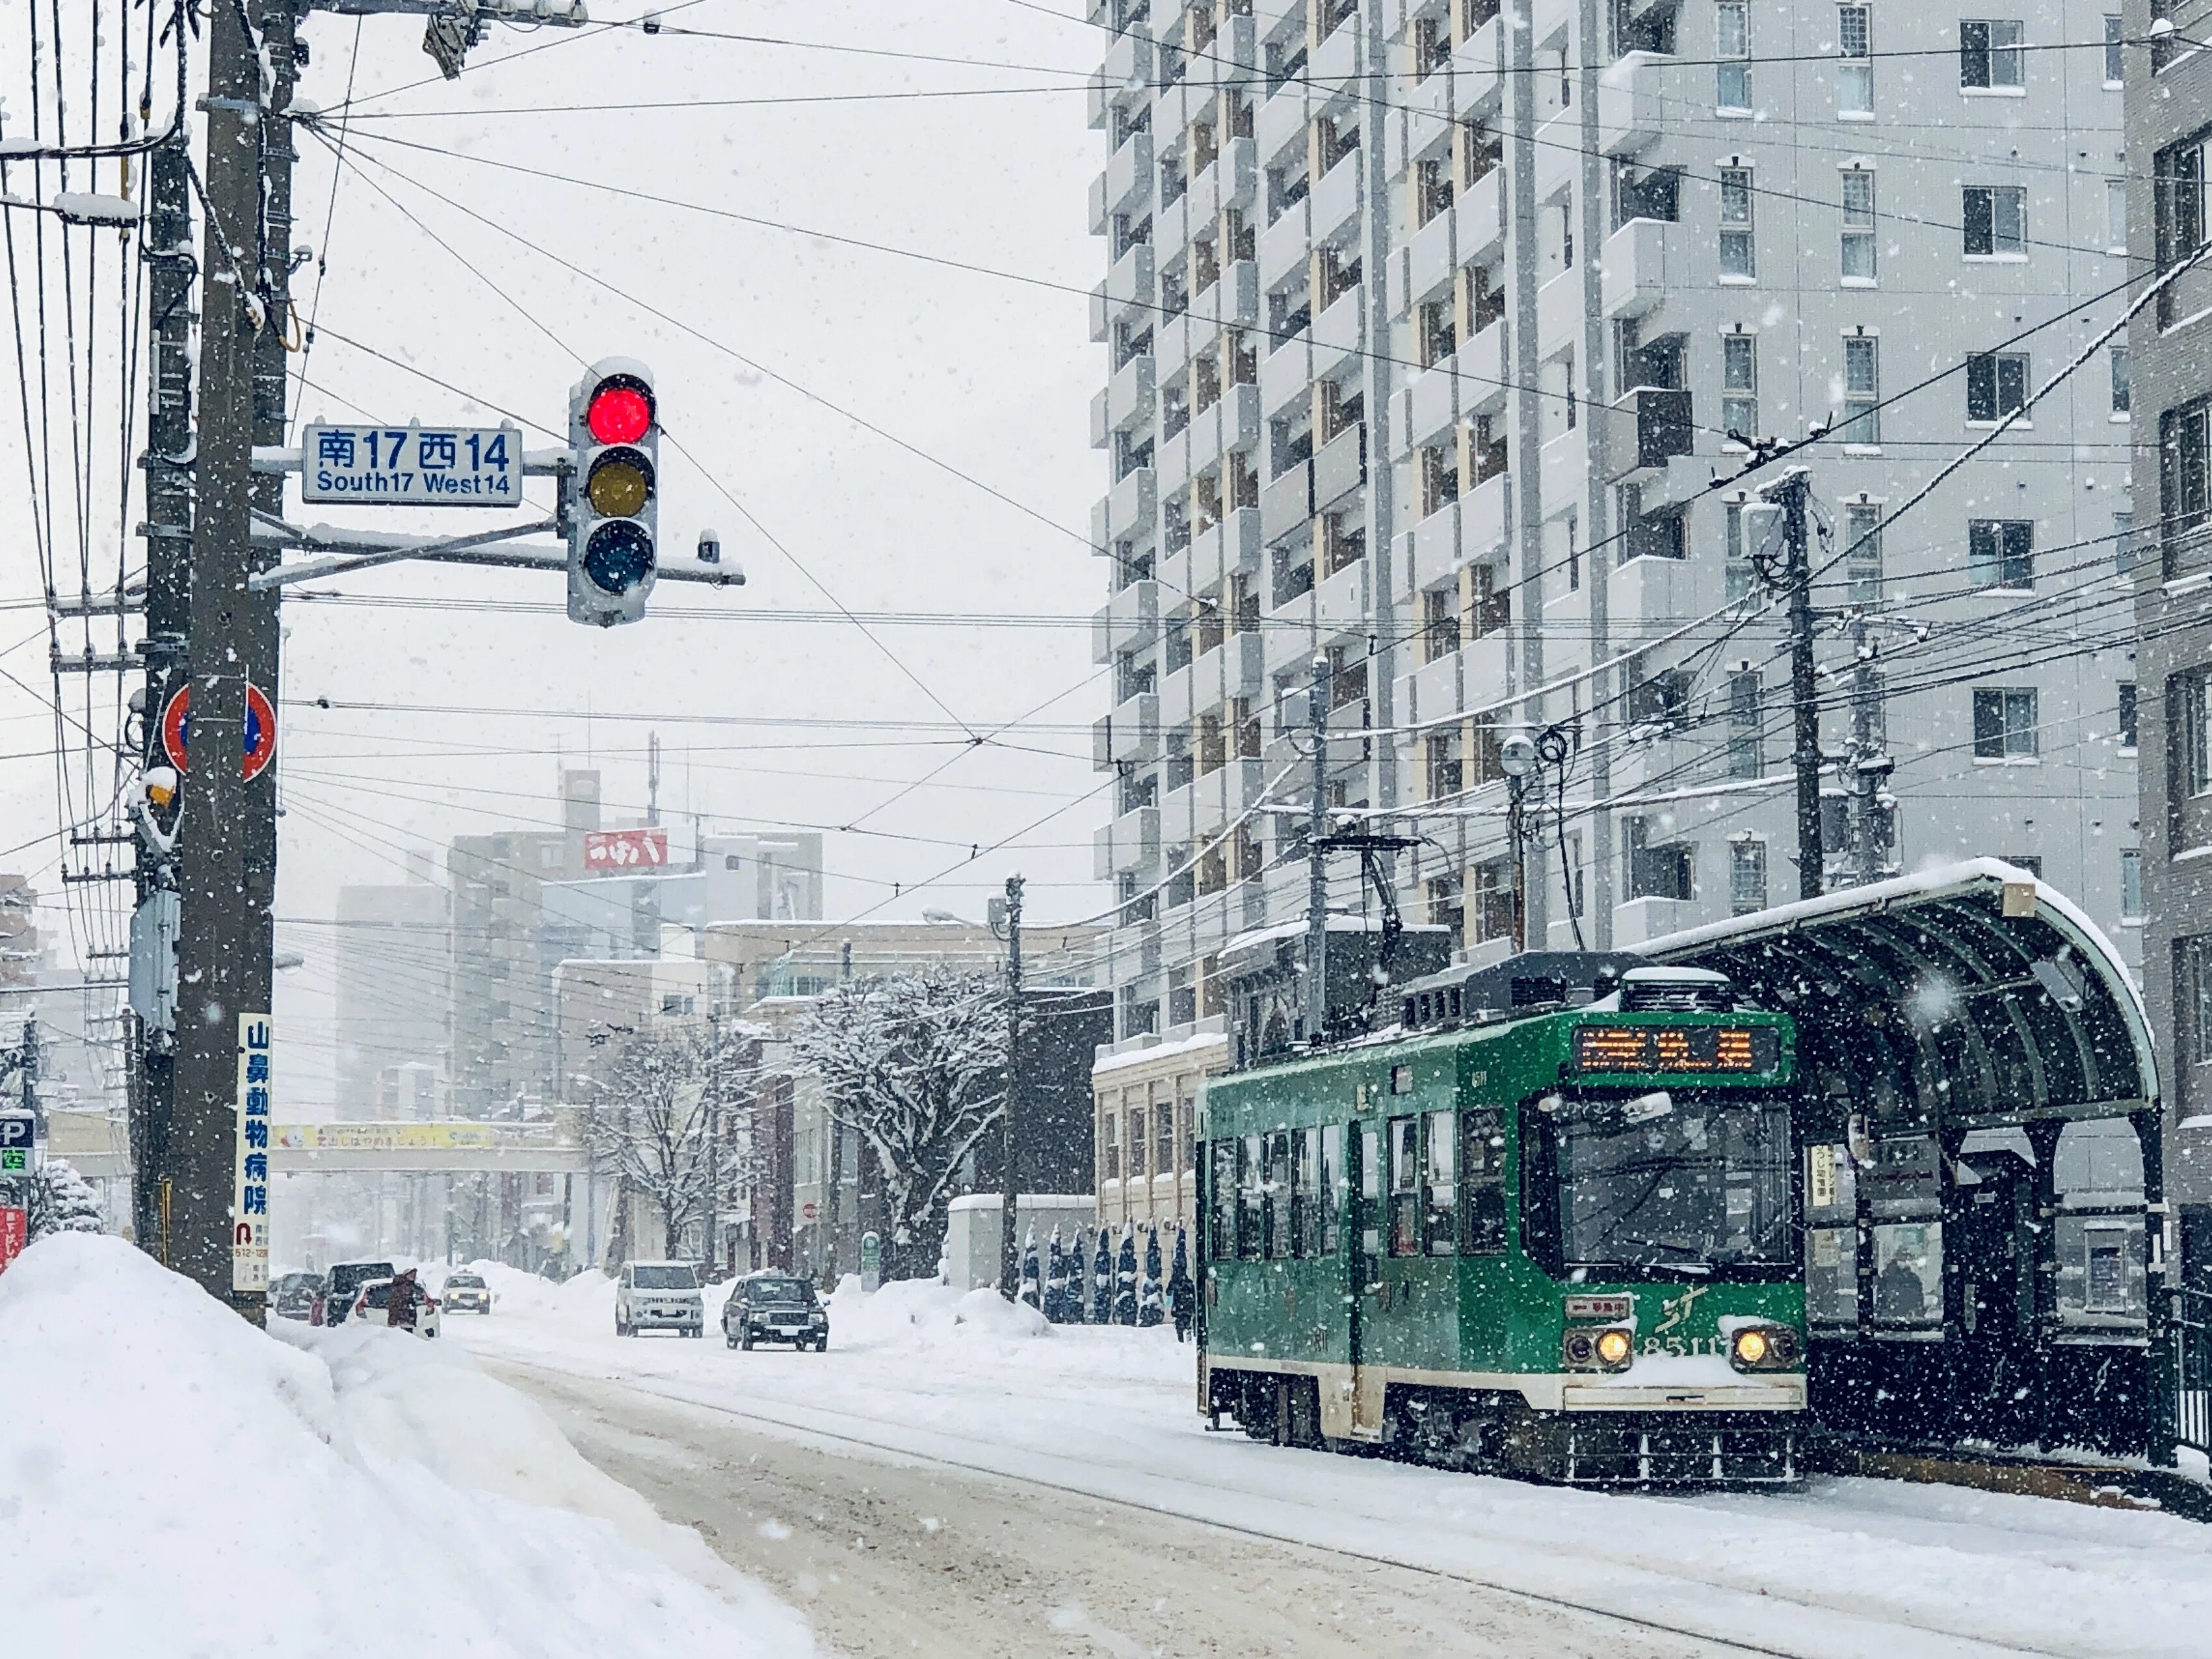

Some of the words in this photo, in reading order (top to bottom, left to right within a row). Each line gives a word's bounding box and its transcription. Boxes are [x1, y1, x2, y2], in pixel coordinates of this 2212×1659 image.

[317, 429, 510, 472] 南17西14
[317, 471, 414, 492] South17
[424, 473, 510, 495] West14
[3, 1121, 26, 1145] P
[244, 1022, 269, 1215] 山鼻動物病院
